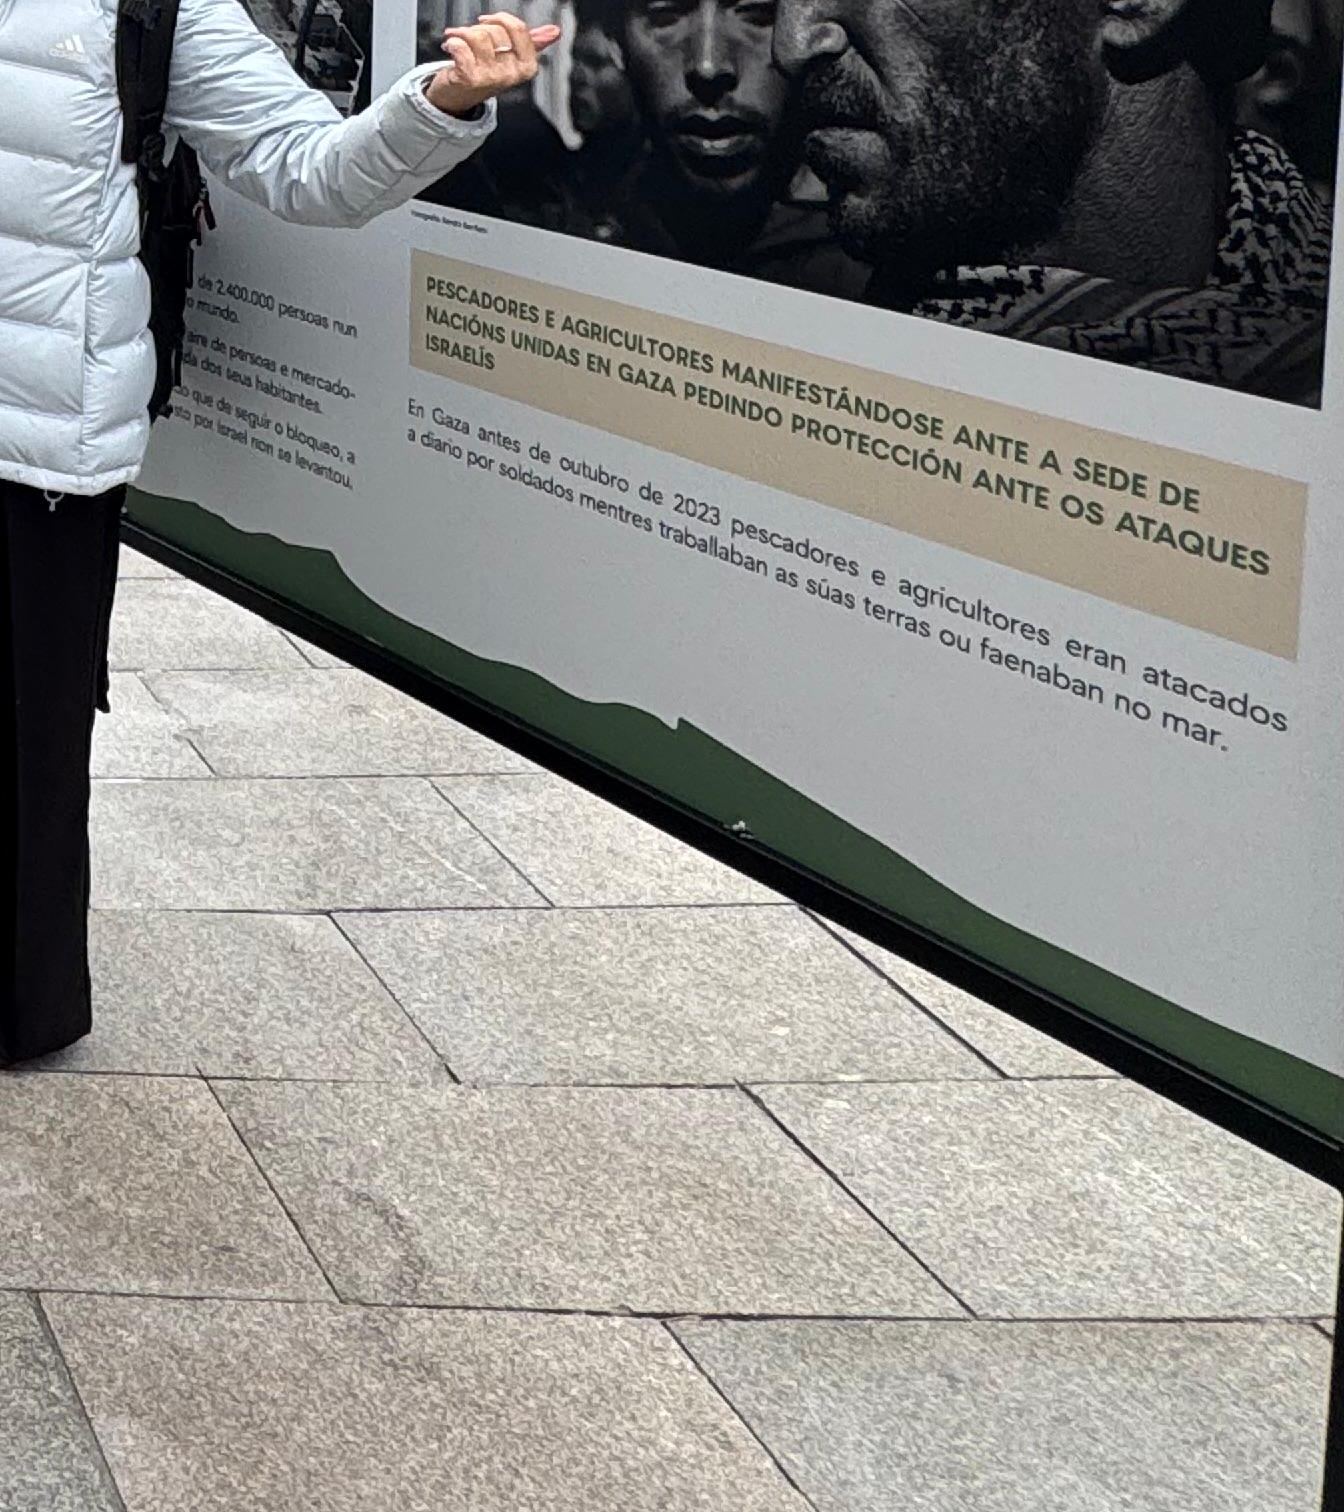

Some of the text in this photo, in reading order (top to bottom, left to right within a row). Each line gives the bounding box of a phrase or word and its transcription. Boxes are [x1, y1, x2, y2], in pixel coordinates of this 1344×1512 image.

[278, 301, 329, 330] persoas
[333, 318, 358, 339] nun
[425, 333, 496, 371] ISRAELÍS
[211, 336, 227, 354] de
[229, 346, 276, 372] persoas
[280, 364, 289, 376] e
[291, 367, 356, 400] mercado-
[426, 276, 1200, 514] PESCADORES E AGRICULTORES MANIFESTÁNDOSE ANTE A SEDE DE
[216, 396, 232, 415] de
[275, 422, 283, 436] o
[287, 423, 344, 462] bloqueo,
[346, 451, 356, 465] a
[251, 437, 274, 457] non
[278, 447, 292, 463] se
[426, 305, 1271, 577] NACIÓNS UNIDAS EN GAZA PEDINDO PROTECCIÓN ANTE OS ATAQUES
[407, 427, 1230, 753] a diario por soldados mentres traballaban as súas terras ou faenaban no mar.
[408, 397, 1289, 733] En Gaza antes de outubro de 2023 pescadores e agricultores eran atacados
